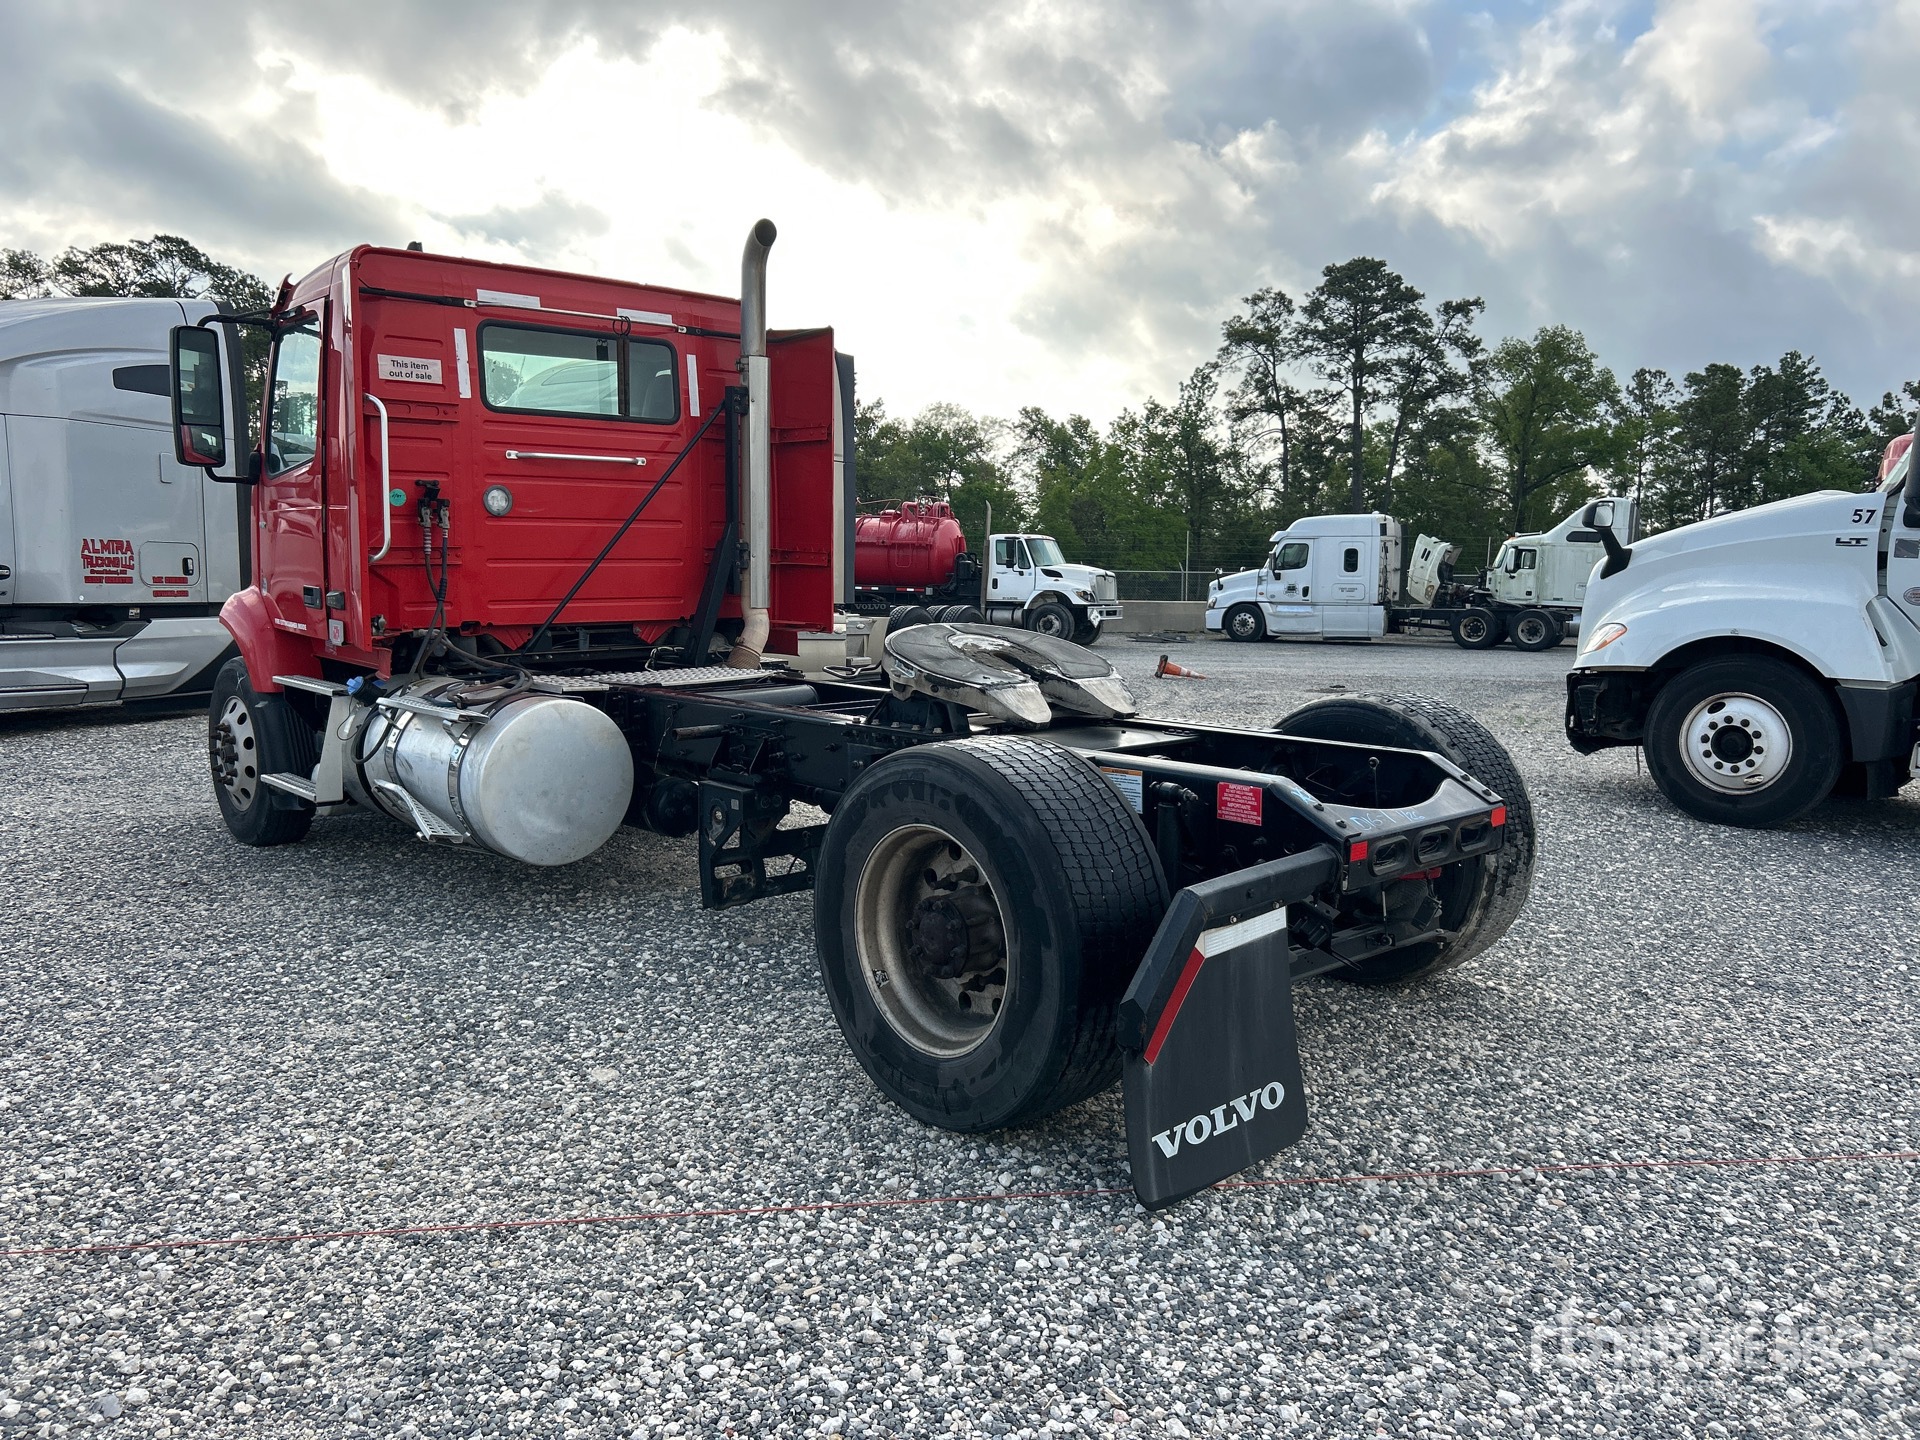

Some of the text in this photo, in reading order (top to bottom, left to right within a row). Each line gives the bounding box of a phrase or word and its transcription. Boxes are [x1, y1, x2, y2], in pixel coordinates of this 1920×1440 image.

[391, 359, 429, 370] This item
[389, 370, 432, 380] out of sale
[1852, 508, 1877, 524] 57
[81, 538, 134, 555] ALMIRA
[1835, 537, 1868, 546] LT
[81, 553, 135, 570] TRUCKING LLC
[1151, 1081, 1285, 1159] VOLVO
